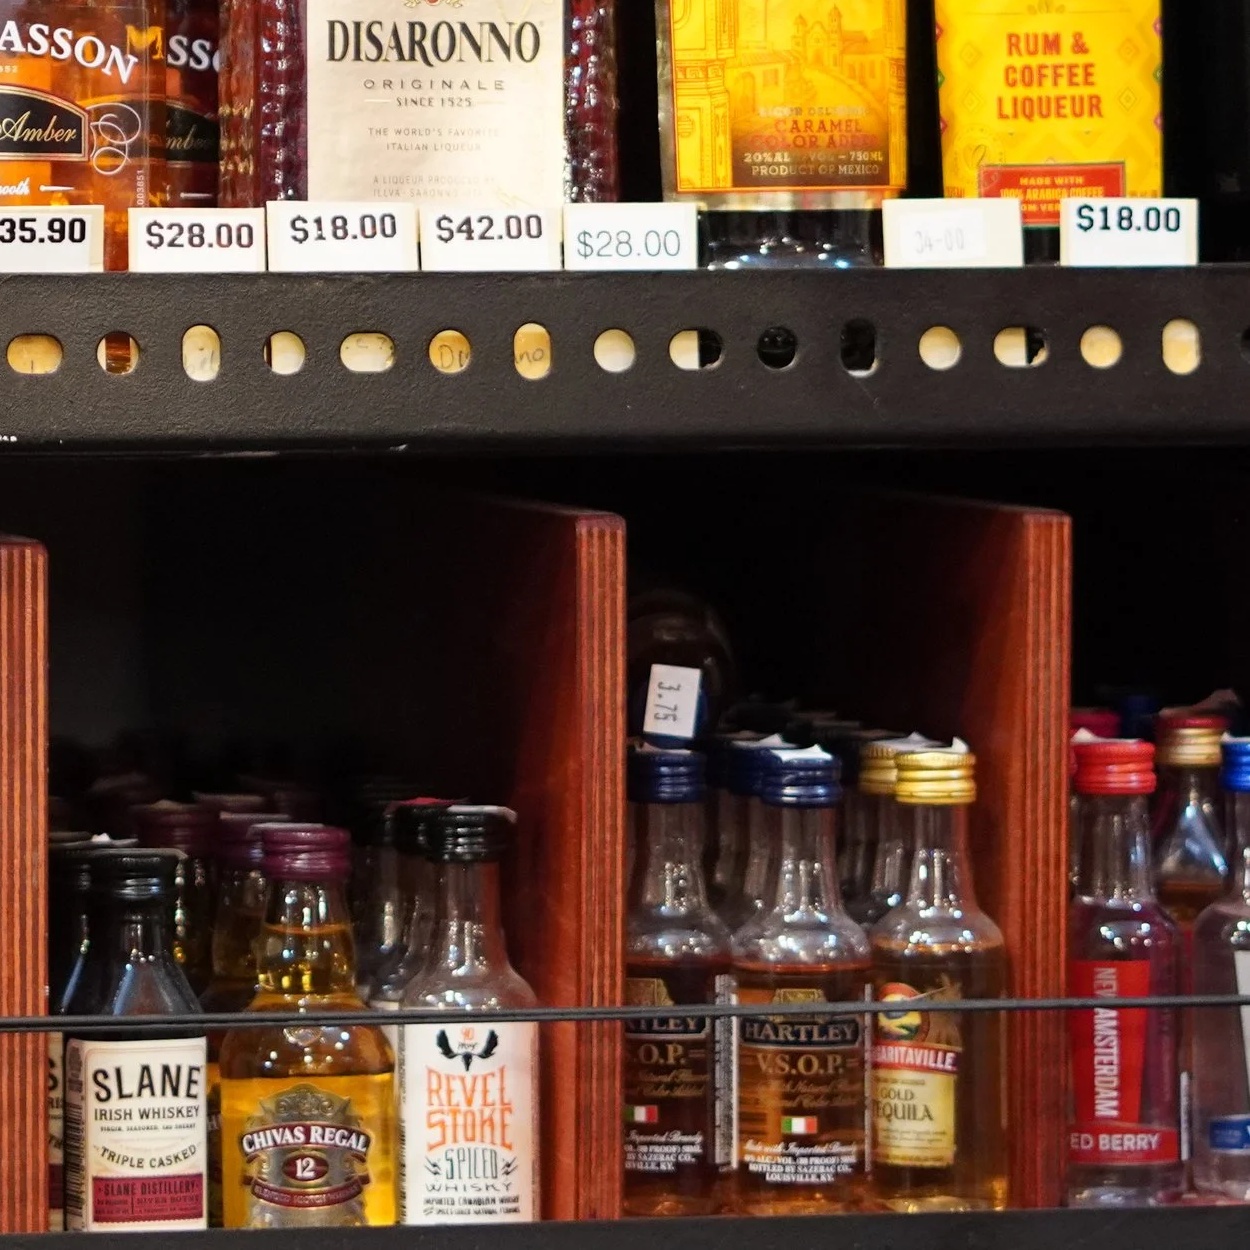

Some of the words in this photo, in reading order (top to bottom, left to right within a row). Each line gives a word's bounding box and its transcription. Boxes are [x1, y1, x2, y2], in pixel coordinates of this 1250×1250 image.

[326, 19, 542, 68] DISARONNO
[1007, 32, 1062, 56] RUM
[1071, 31, 1090, 56] &
[363, 78, 506, 91] ORIGINALE
[1004, 63, 1096, 88] COFFEE
[396, 97, 435, 108] SINCE
[440, 97, 473, 108] 1525
[996, 94, 1103, 120] LIQUEUR
[368, 127, 389, 137] THE
[393, 127, 443, 137] WORLD'S
[774, 118, 863, 134] CARAMEL
[386, 142, 429, 151] ITALIAN
[750, 134, 818, 150] COLOR
[751, 164, 815, 176] PRODUCT
[838, 164, 880, 176] MEXICO
[1019, 176, 1052, 186] MADE
[1054, 176, 1085, 186] WITH
[289, 213, 397, 245] $18.00
[435, 213, 544, 245] $42.00
[1076, 203, 1181, 233] $18.00
[145, 220, 255, 250] $28.00
[576, 229, 681, 260] $28.00
[653, 681, 682, 723] 3.75
[745, 1022, 855, 1042] HARTLEY
[756, 1052, 844, 1076] V.S.O.P.
[1093, 1007, 1120, 1118] AMSTERDAM
[91, 1063, 202, 1103] SLANE
[425, 1064, 514, 1108] REVEL
[879, 1087, 915, 1102] GOLD
[94, 1108, 134, 1122] IRISH
[137, 1104, 200, 1121] WHISKEY
[242, 1125, 306, 1153] CHIVAS
[309, 1125, 368, 1153] REGAL
[425, 1107, 514, 1151] STOKE
[1070, 1133, 1093, 1150] ED
[1098, 1133, 1161, 1151] BERRY
[100, 1145, 145, 1170] TRIPLE
[149, 1143, 198, 1169] CASKED
[294, 1156, 316, 1179] 12
[103, 1182, 137, 1197] SLANE
[140, 1180, 196, 1195] DISTILLERY
[425, 1181, 513, 1193] WHISKY
